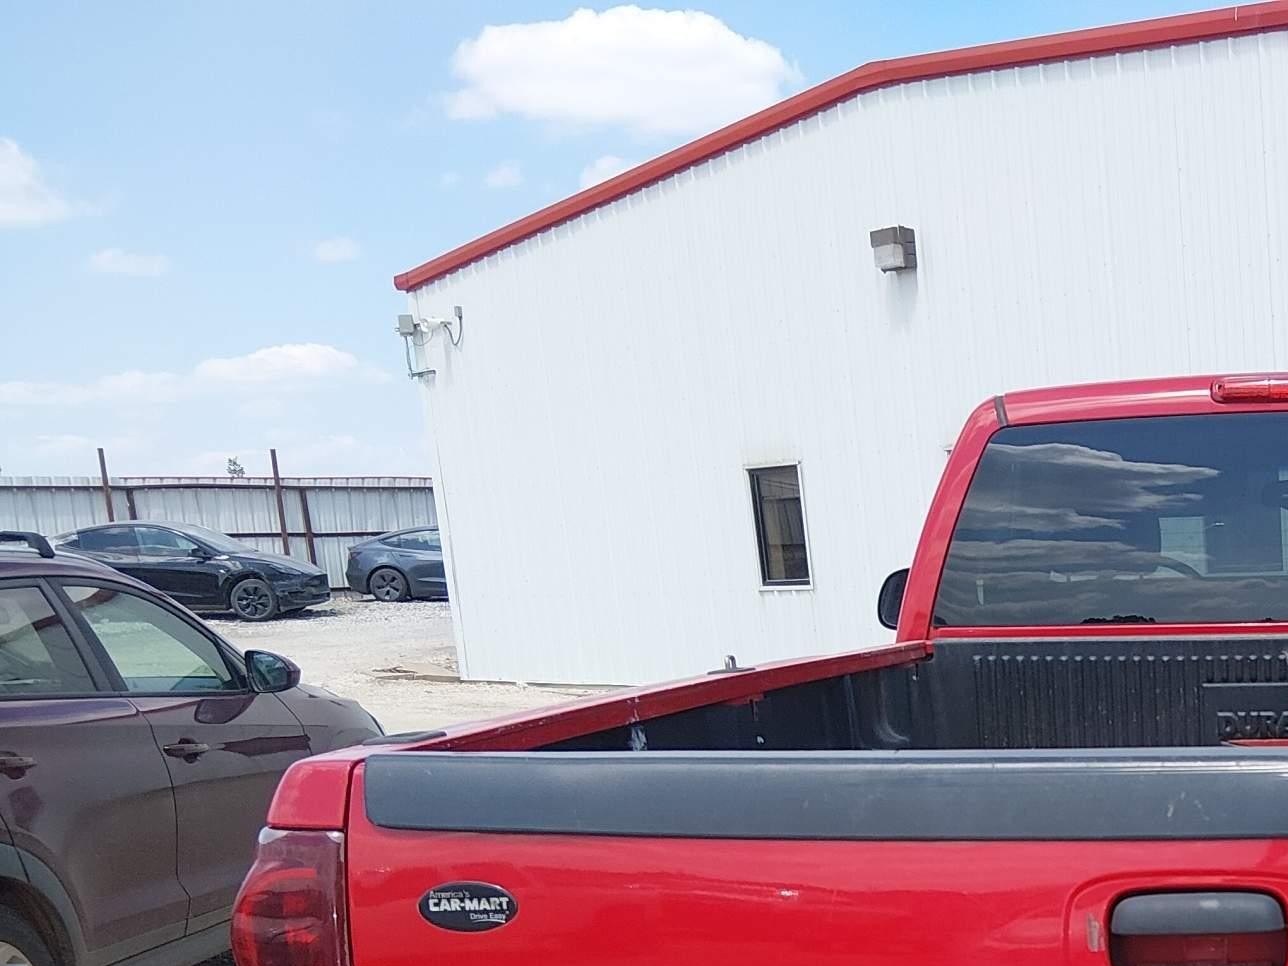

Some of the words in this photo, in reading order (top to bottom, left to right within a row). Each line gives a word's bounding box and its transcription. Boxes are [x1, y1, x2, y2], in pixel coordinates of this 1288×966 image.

[429, 889, 470, 899] America's
[428, 897, 509, 911] CAR-MART
[489, 912, 506, 921] Easy
